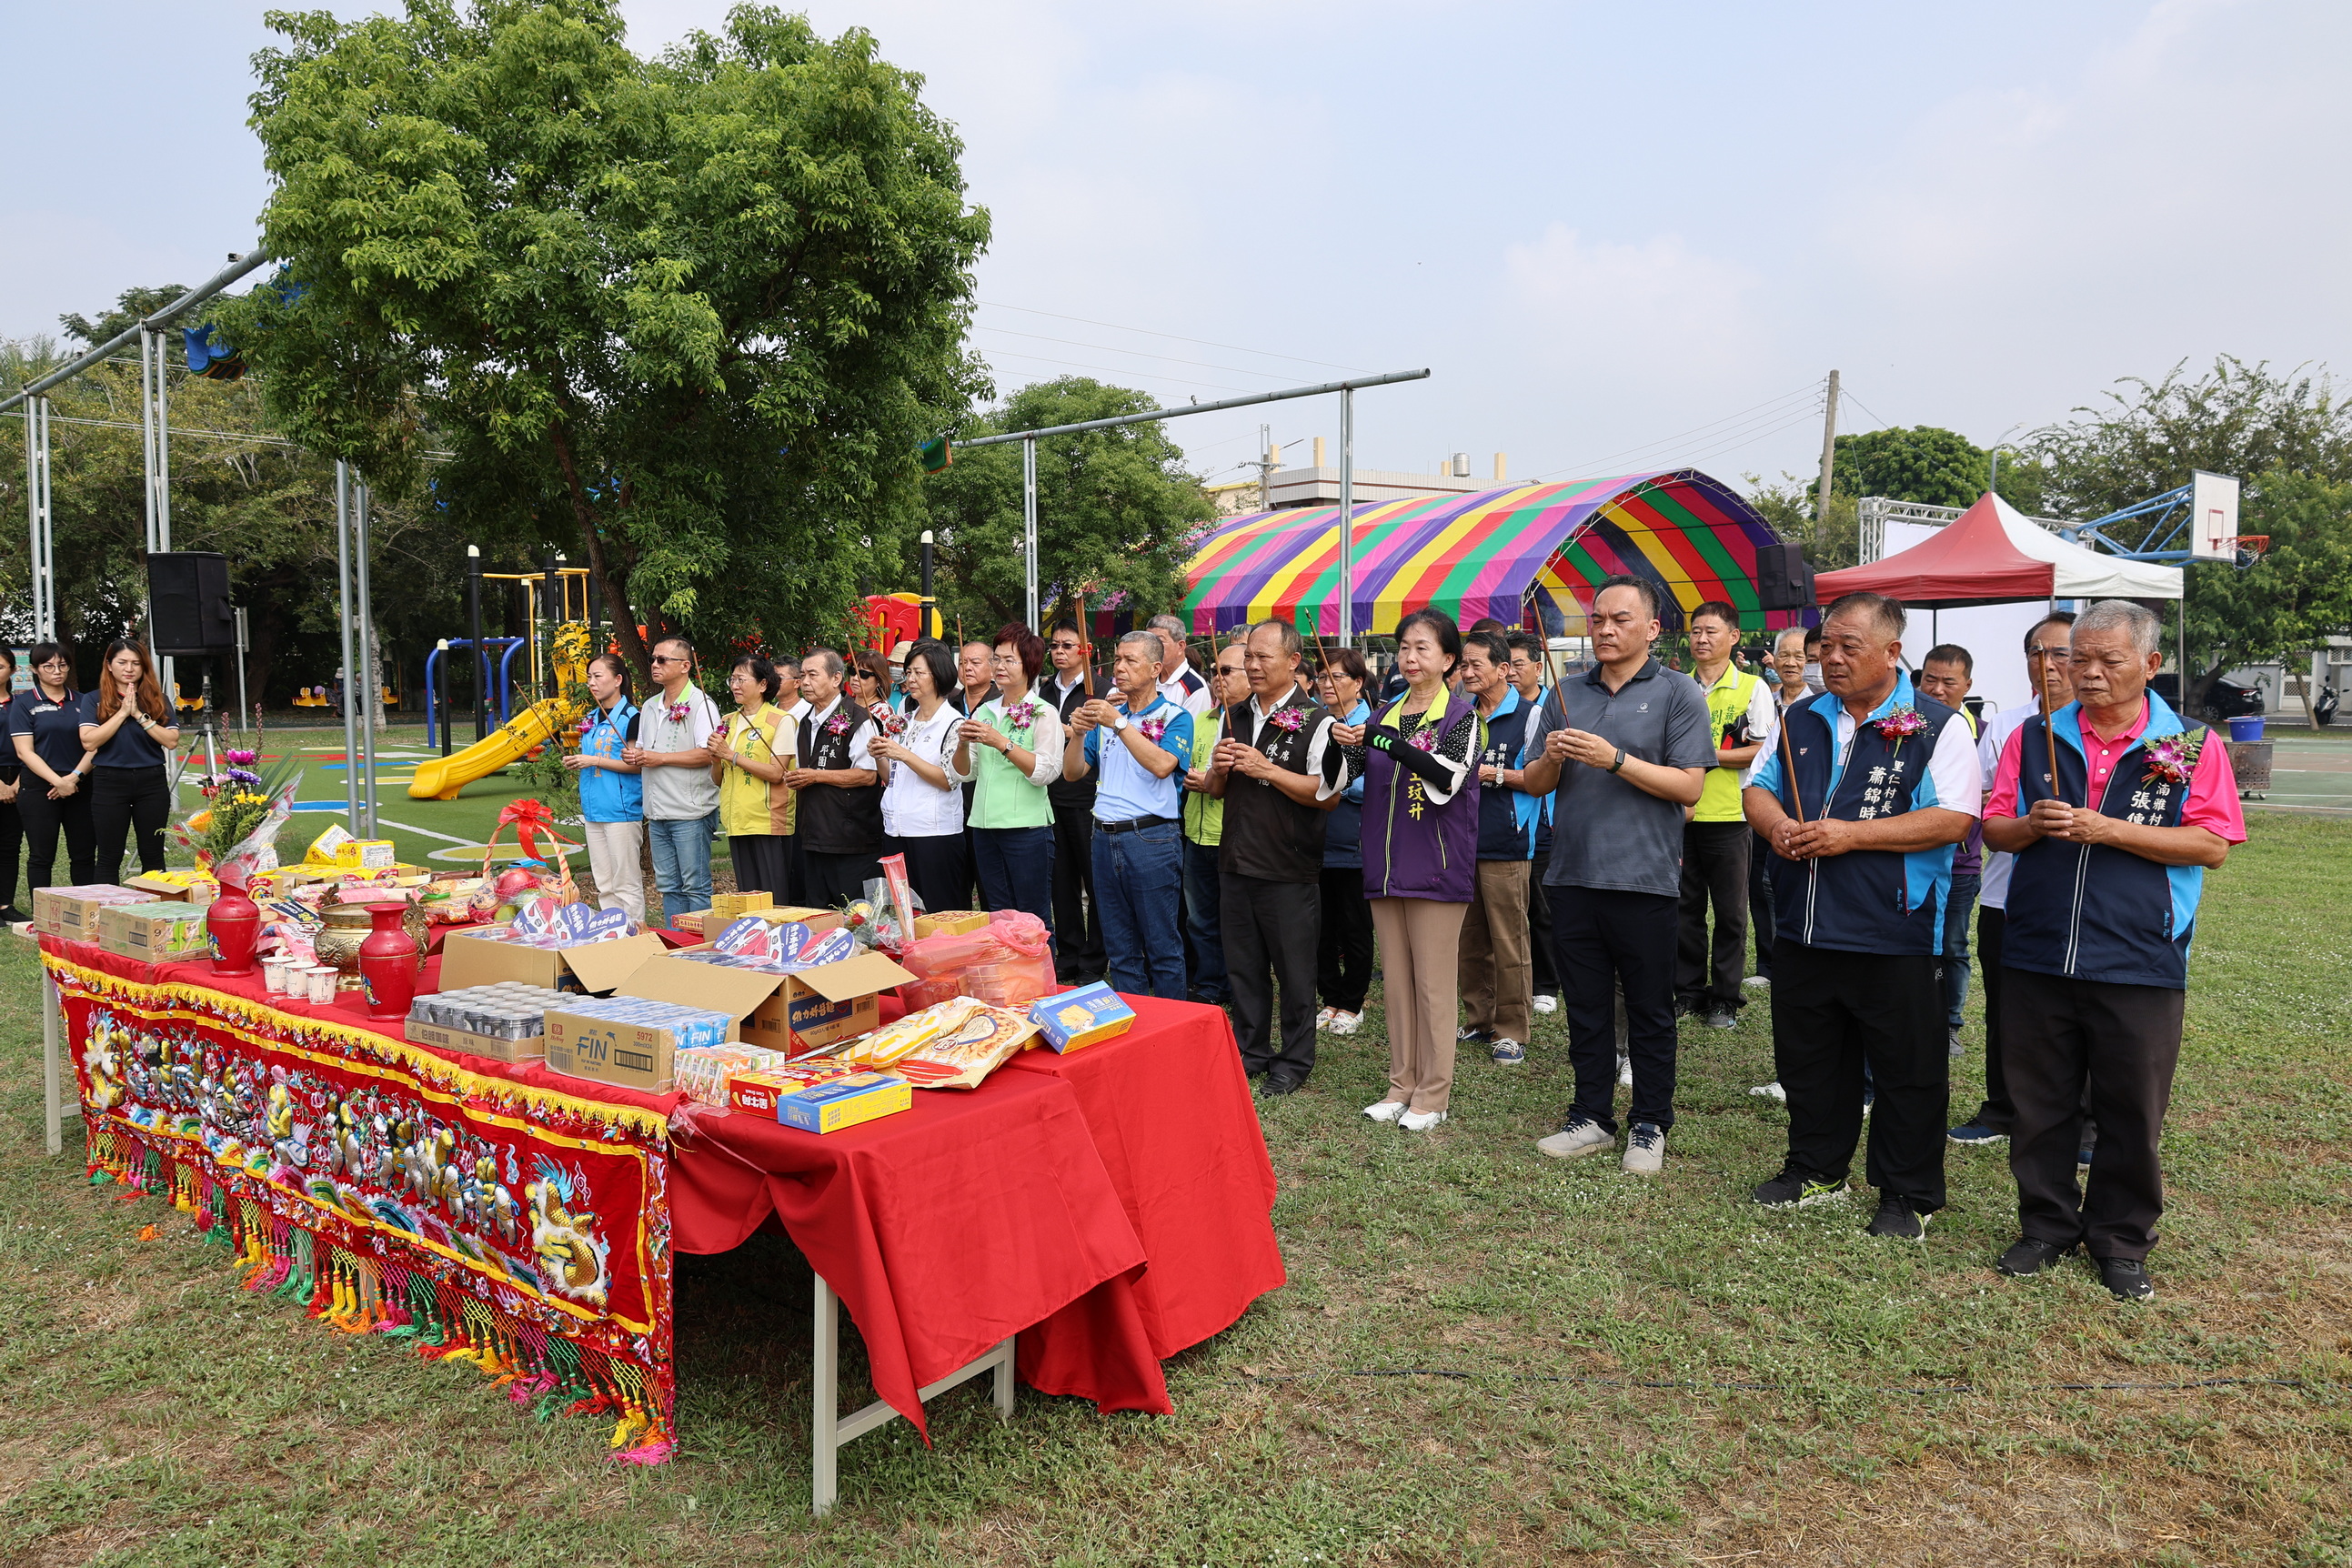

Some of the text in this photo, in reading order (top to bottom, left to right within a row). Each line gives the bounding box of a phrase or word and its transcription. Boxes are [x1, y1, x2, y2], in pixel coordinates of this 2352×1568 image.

[1724, 704, 1735, 725] 社頭
[1279, 734, 1294, 762] 主席
[744, 741, 755, 786] 彰化員
[1858, 766, 1887, 820] 蕭錦時
[1880, 759, 1905, 815] 里仁村長
[2147, 782, 2171, 827] 湳雅村
[88, 921, 95, 930] 9
[89, 910, 96, 920] 8
[154, 928, 162, 938] 9
[636, 1030, 653, 1042] 5972
[690, 1030, 711, 1044] FIN
[576, 1035, 608, 1061] FIN
[741, 1094, 769, 1110] 金牛角
